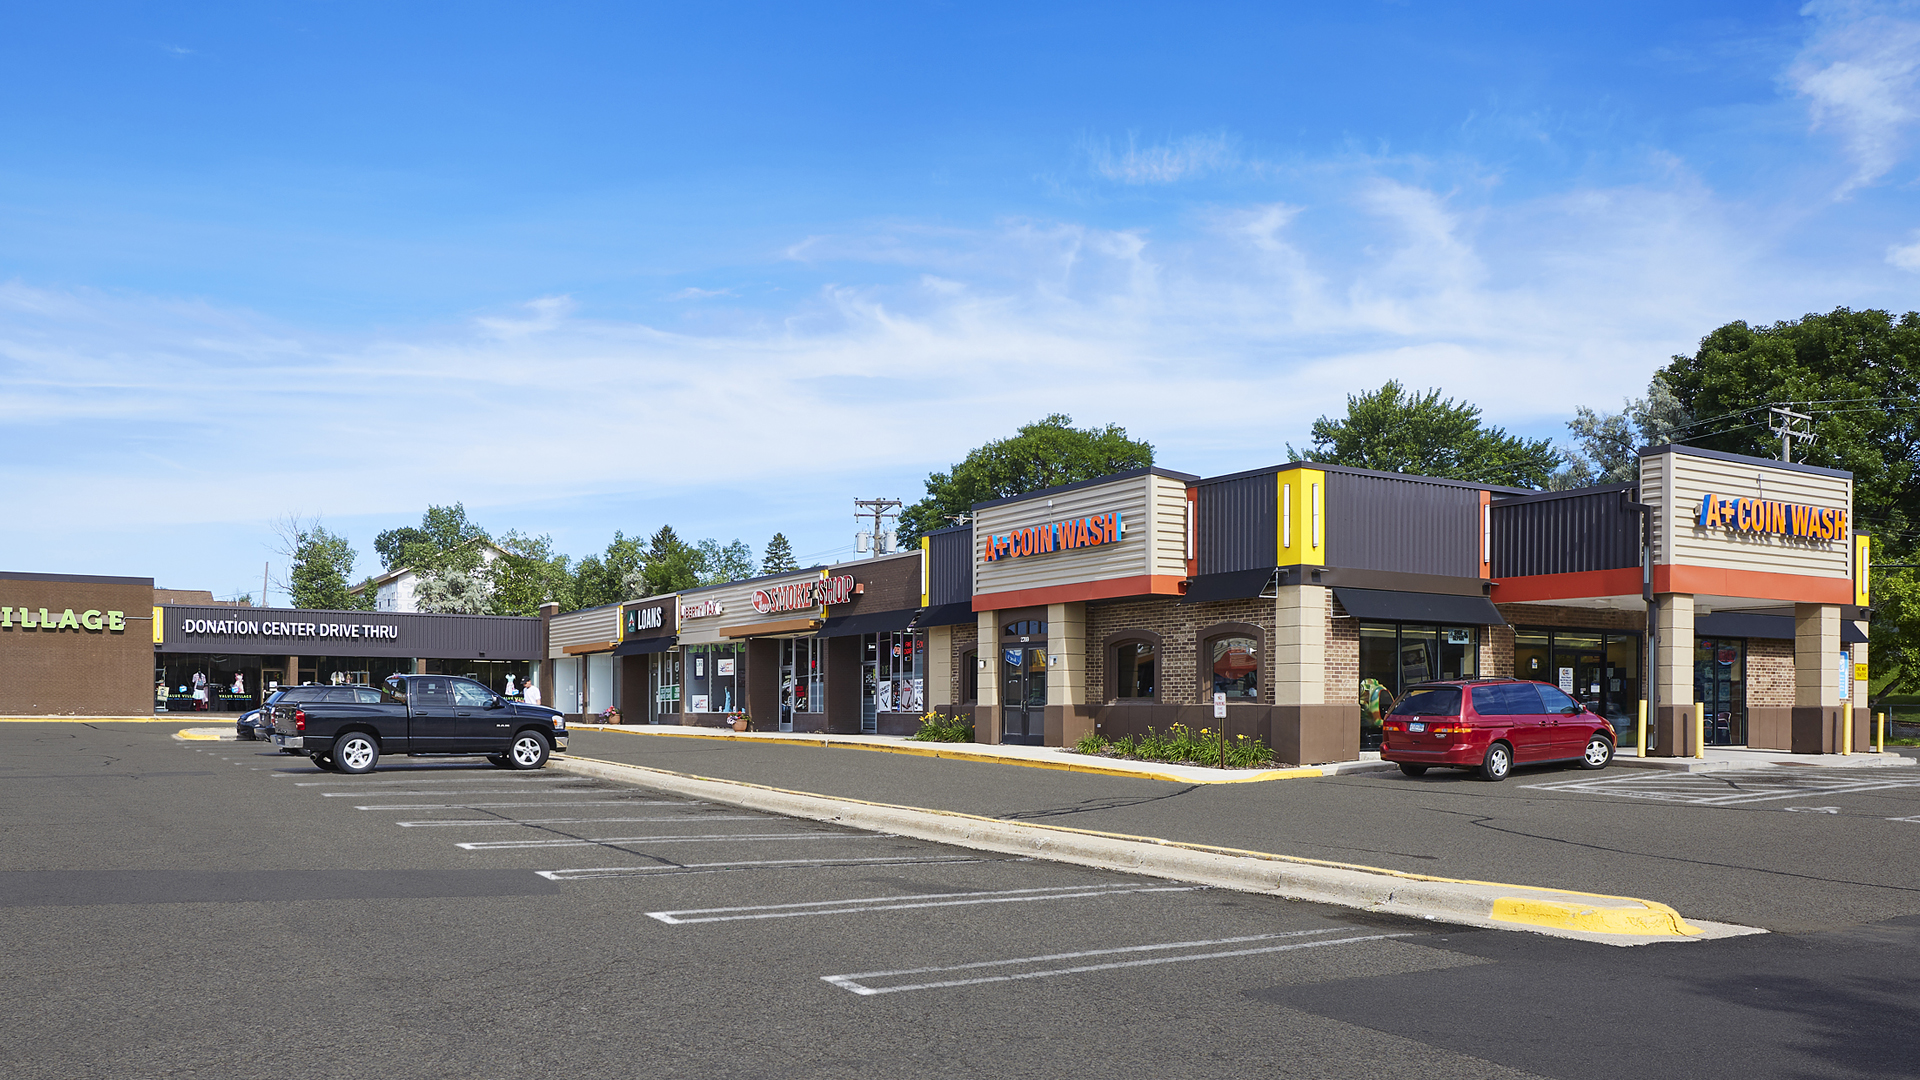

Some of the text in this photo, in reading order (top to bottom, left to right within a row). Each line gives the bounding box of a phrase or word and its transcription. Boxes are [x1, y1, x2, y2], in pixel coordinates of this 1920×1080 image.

[1702, 493, 1846, 541] A+ COIN WASH
[984, 512, 1121, 562] A+ COIN WASH
[770, 575, 854, 613] SMOKE SHOP
[185, 618, 399, 639] DONATION CENTER DRIVE THRU
[637, 606, 662, 630] LOANS
